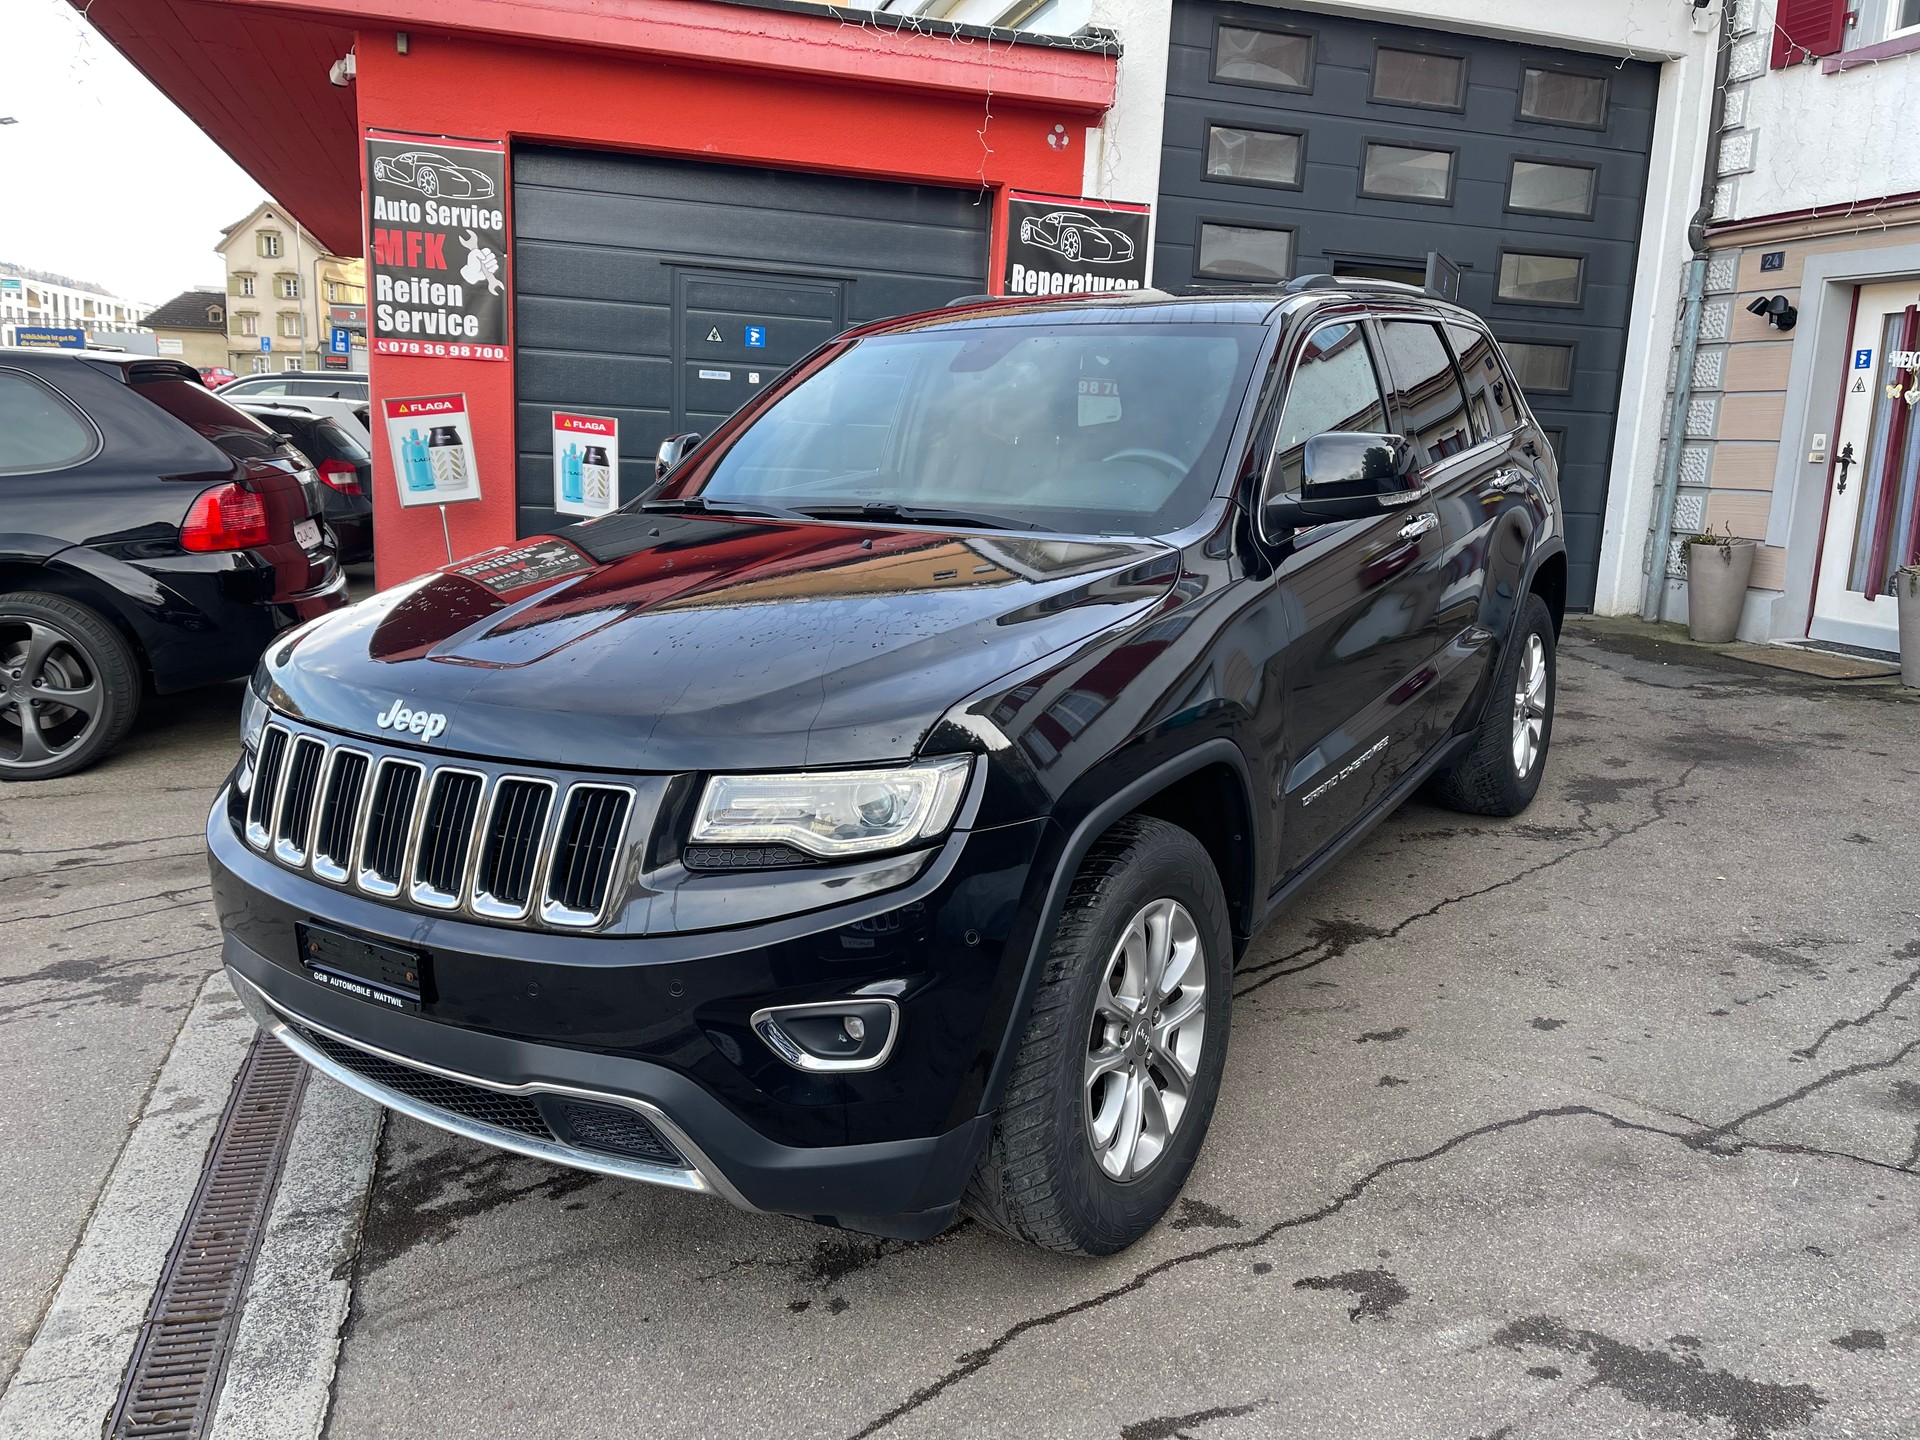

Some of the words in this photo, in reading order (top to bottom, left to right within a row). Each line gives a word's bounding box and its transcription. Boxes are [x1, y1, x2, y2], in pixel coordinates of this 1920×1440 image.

[374, 195, 420, 223] Auto
[425, 199, 503, 230] Service
[374, 229, 448, 270] MFK
[1764, 255, 1780, 268] 24
[376, 274, 463, 307] Reifen
[377, 305, 479, 337] Service
[337, 330, 345, 341] P
[389, 341, 419, 353] 079
[424, 343, 445, 355] 36
[449, 345, 470, 357] 98
[474, 347, 504, 359] 700
[1078, 381, 1099, 394] 98
[410, 401, 453, 412] FLAGA
[573, 420, 606, 431] FLAGA
[376, 699, 447, 743] Jeep
[313, 971, 328, 983] GGB
[330, 977, 371, 997] AUTOMOBILE
[373, 990, 403, 1007] WATTWIL
